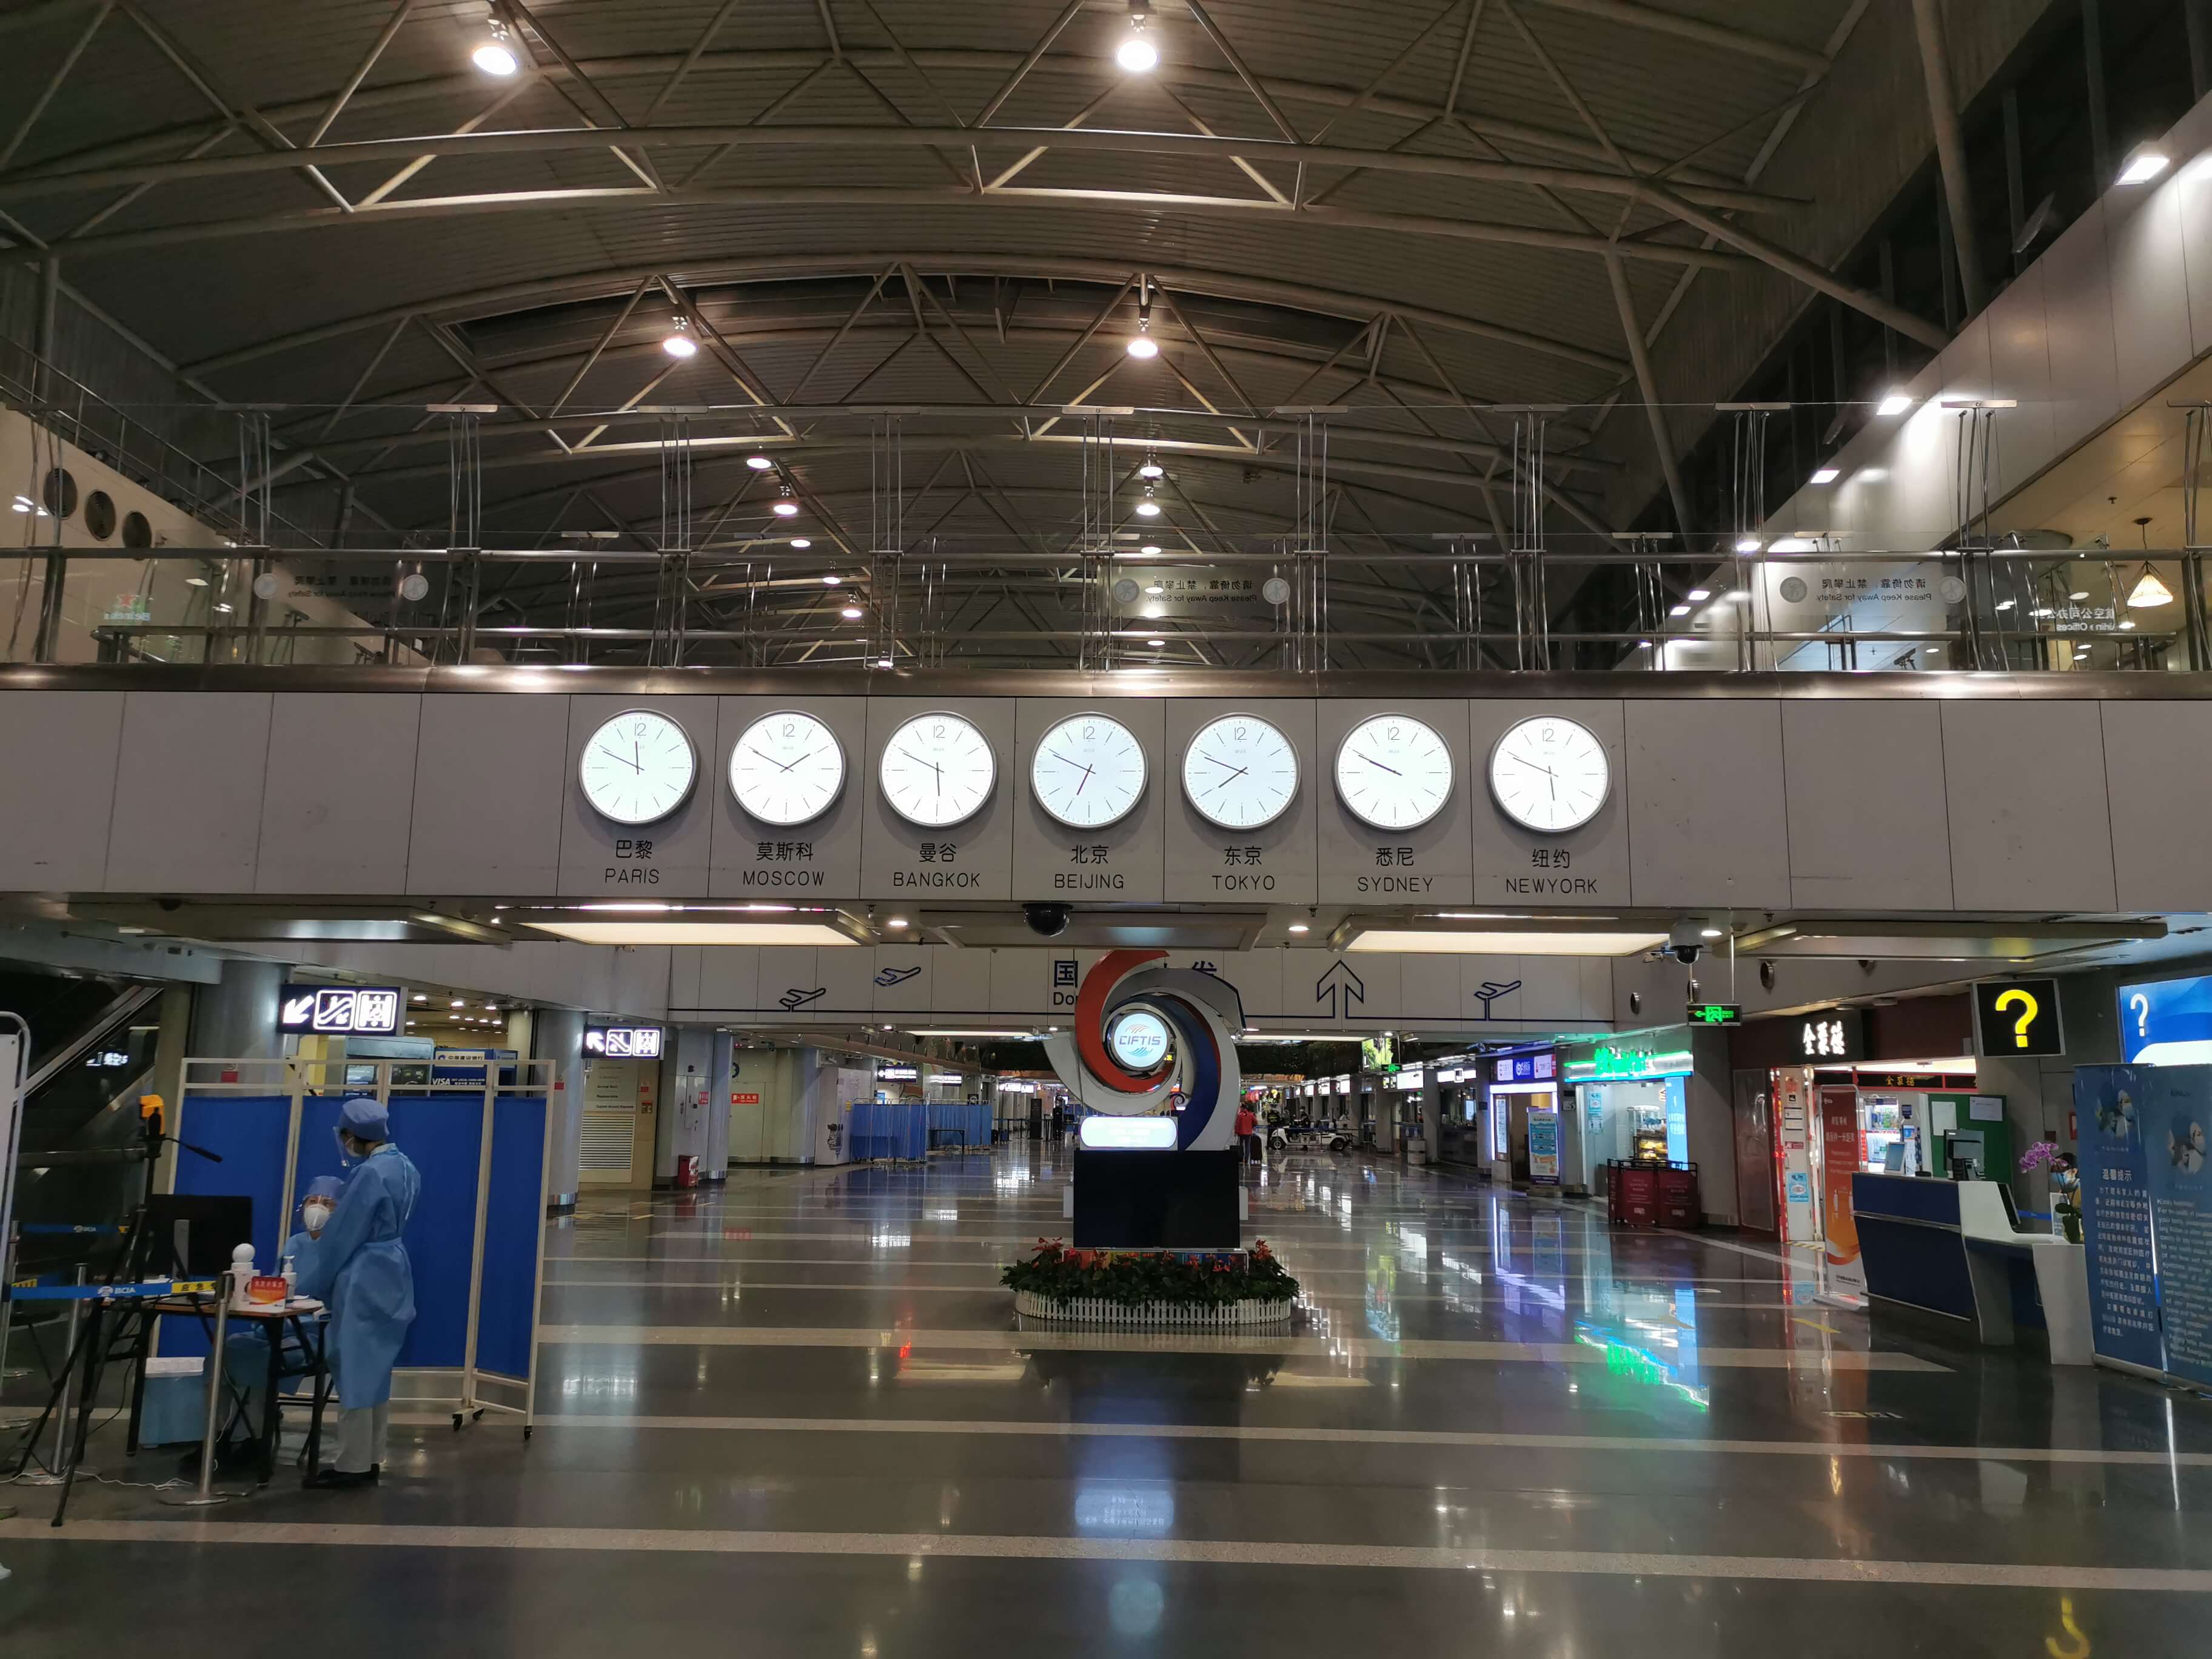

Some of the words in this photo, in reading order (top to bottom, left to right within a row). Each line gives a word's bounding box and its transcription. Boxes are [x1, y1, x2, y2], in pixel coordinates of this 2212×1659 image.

[635, 723, 646, 736] 12
[783, 724, 795, 737] 12
[934, 725, 946, 738] 12
[1084, 726, 1096, 739] 12
[1235, 727, 1247, 740] 12
[1387, 727, 1400, 740] 12
[1542, 728, 1555, 742] 12
[616, 840, 652, 859] 巴黎
[757, 842, 813, 861] 莫斯科
[920, 843, 956, 862] 曼谷
[1071, 845, 1109, 864] 北京
[1224, 846, 1262, 865] 东京
[1376, 848, 1413, 866] 悉尼
[1532, 849, 1570, 868] 纽约
[605, 868, 659, 883] PARIS
[743, 871, 824, 886] MOSCOW
[894, 873, 980, 887] BANGKOK
[1055, 874, 1124, 889] BEIJING
[1212, 876, 1275, 890] TOKYO
[1358, 877, 1433, 892] SYDNEY
[1507, 879, 1597, 893] NEWYORK
[1119, 1036, 1161, 1045] CIFTIS
